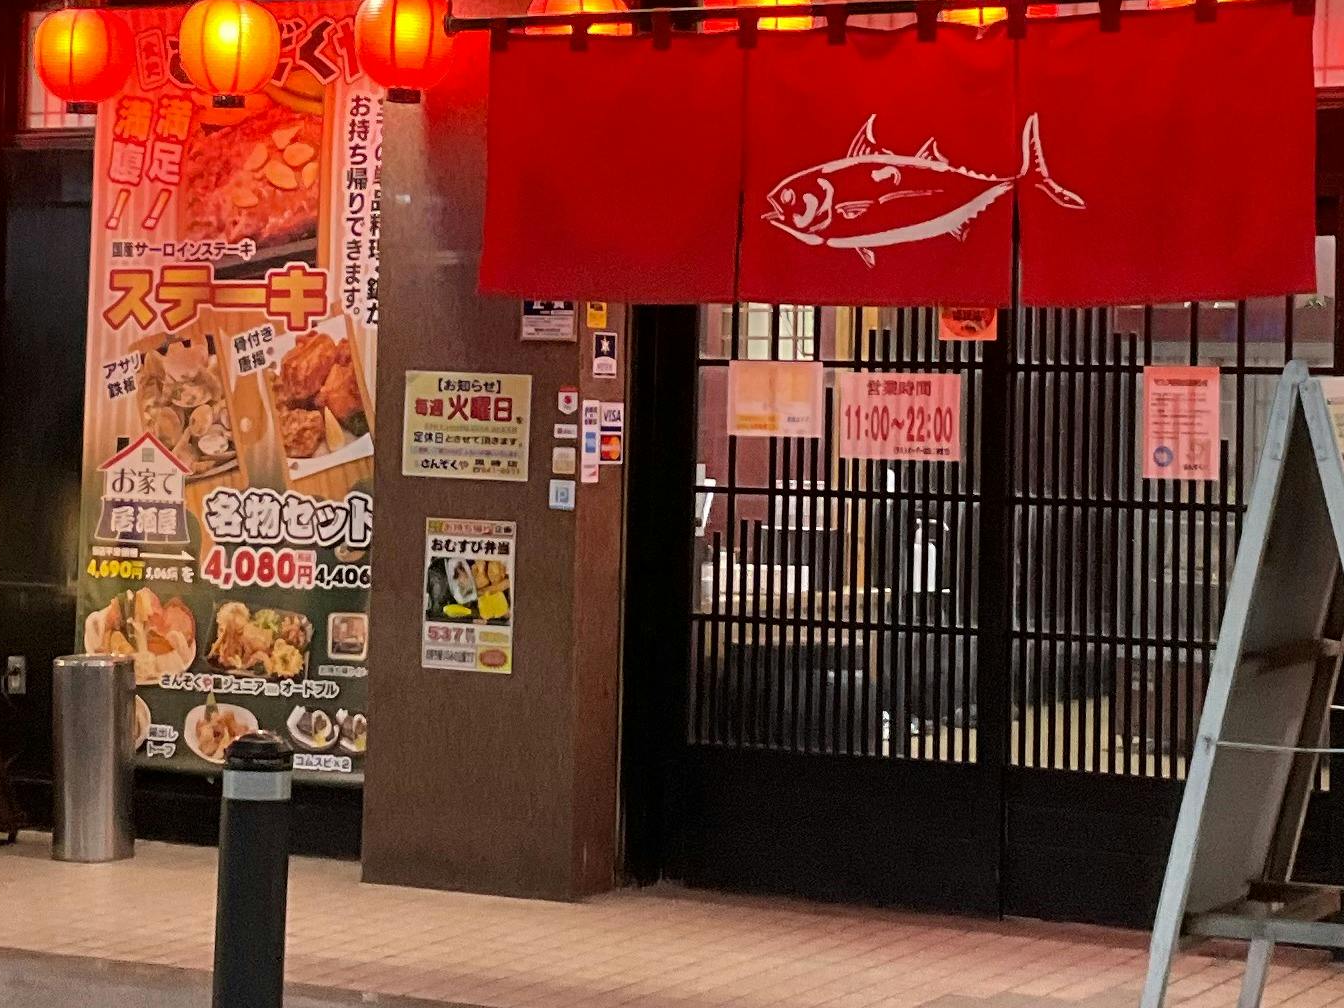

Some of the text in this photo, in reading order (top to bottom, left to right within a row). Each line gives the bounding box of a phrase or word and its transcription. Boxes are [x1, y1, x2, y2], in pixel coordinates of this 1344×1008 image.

[103, 265, 328, 332] ステーキ
[112, 469, 175, 495] お家で
[206, 492, 373, 543] 名物セット
[431, 538, 510, 555] おむすび弁当
